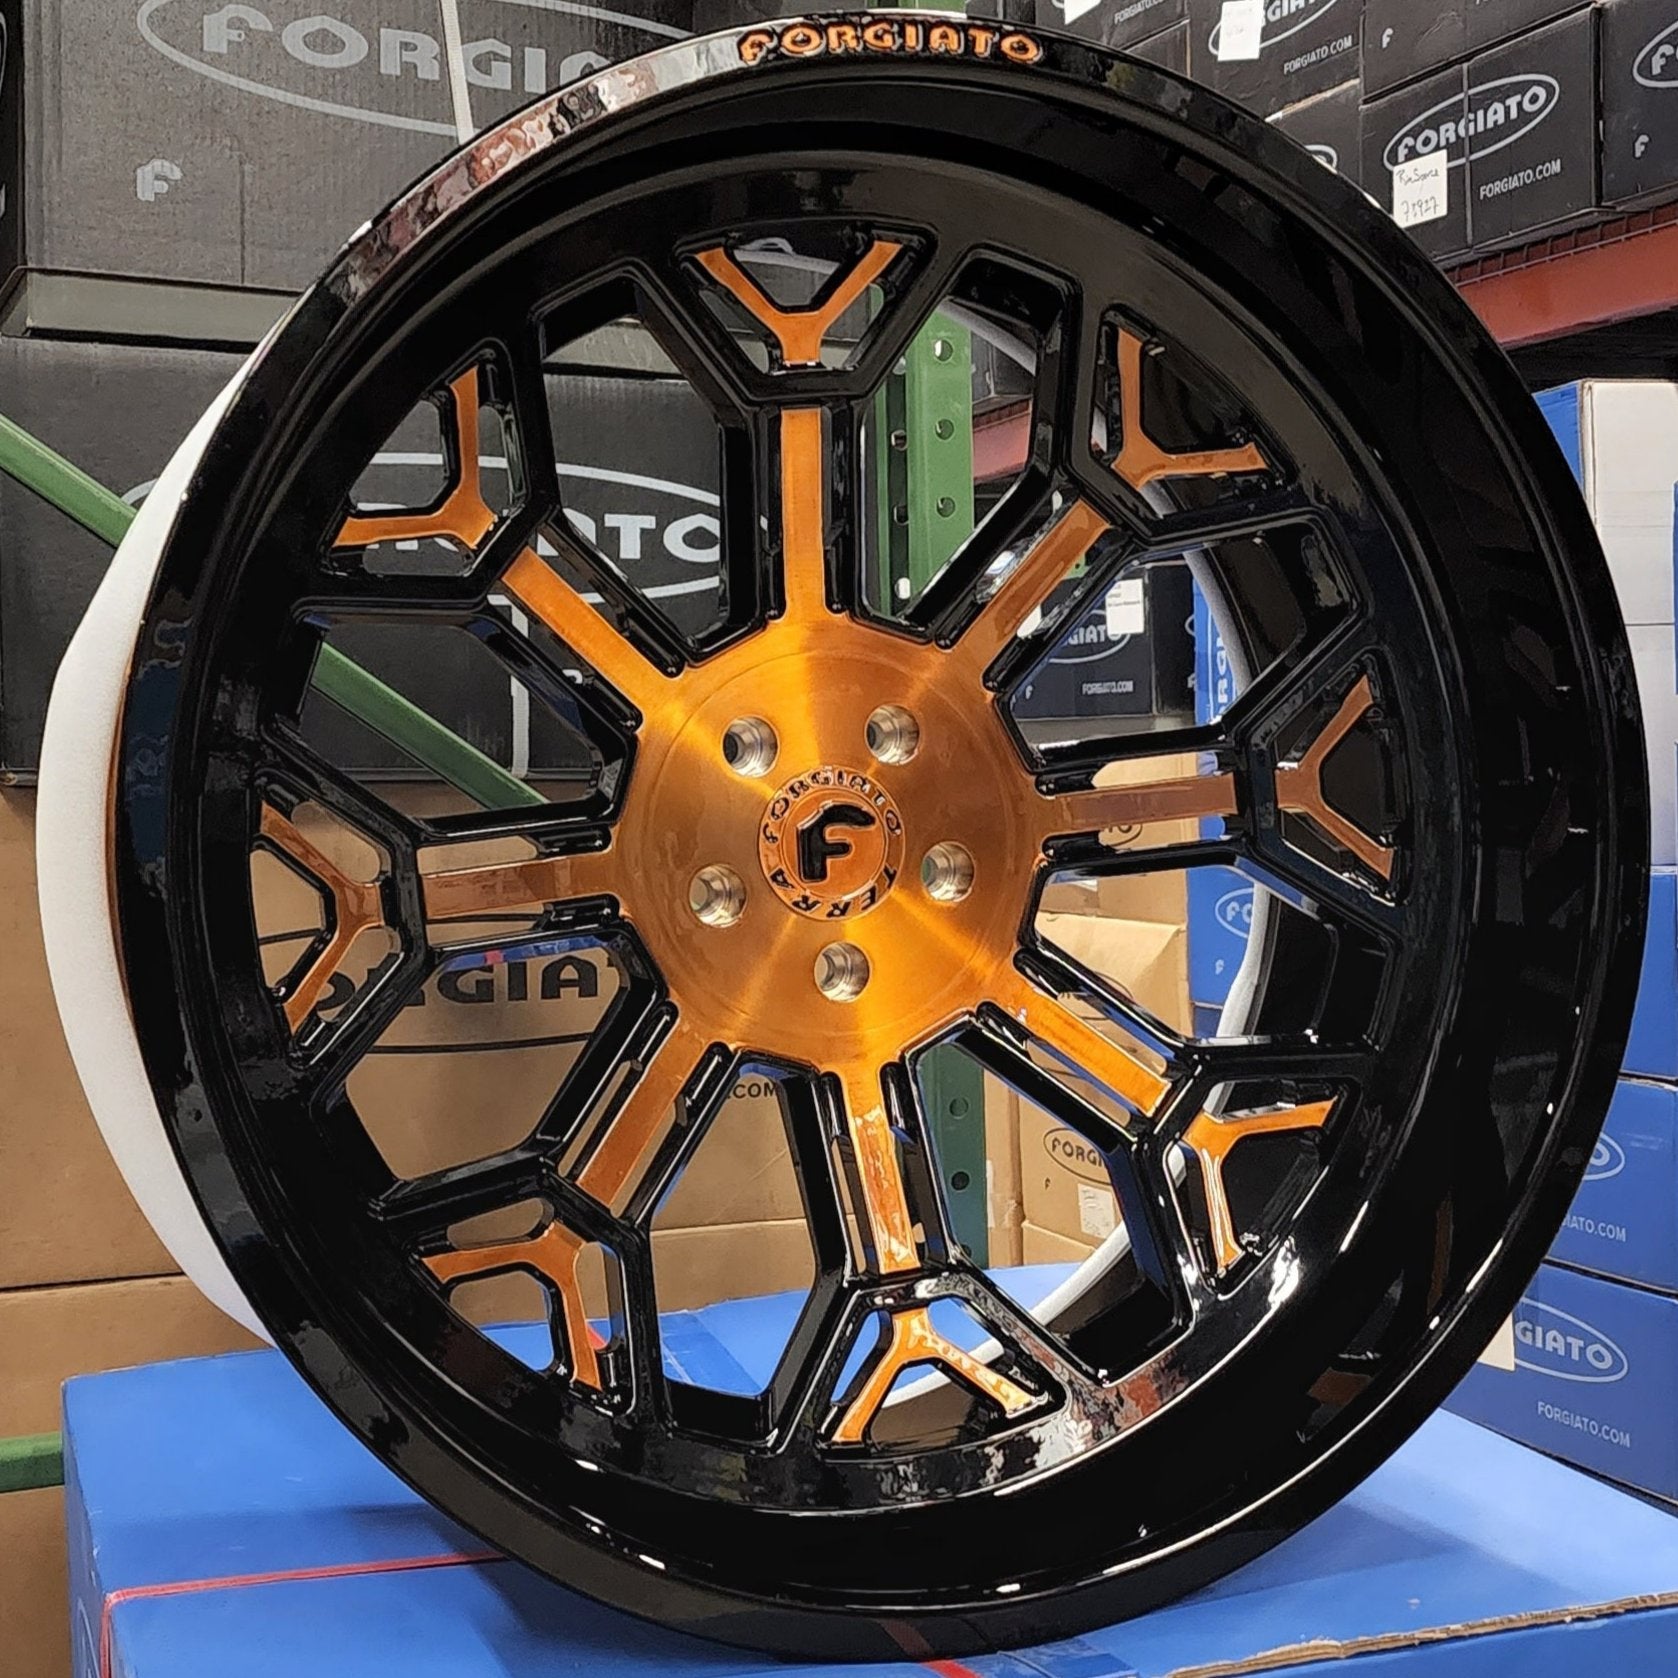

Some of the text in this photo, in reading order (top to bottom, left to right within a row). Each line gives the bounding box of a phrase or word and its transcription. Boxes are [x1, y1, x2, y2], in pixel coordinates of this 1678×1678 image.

[738, 20, 1042, 66] FORGIATO
[1397, 85, 1547, 163] FORGIATO
[1479, 158, 1562, 201] FORGIATO.COM
[762, 768, 902, 844] FORGIATO
[769, 865, 898, 918] TERRA
[1537, 1400, 1631, 1448] FORGIATO.COM
